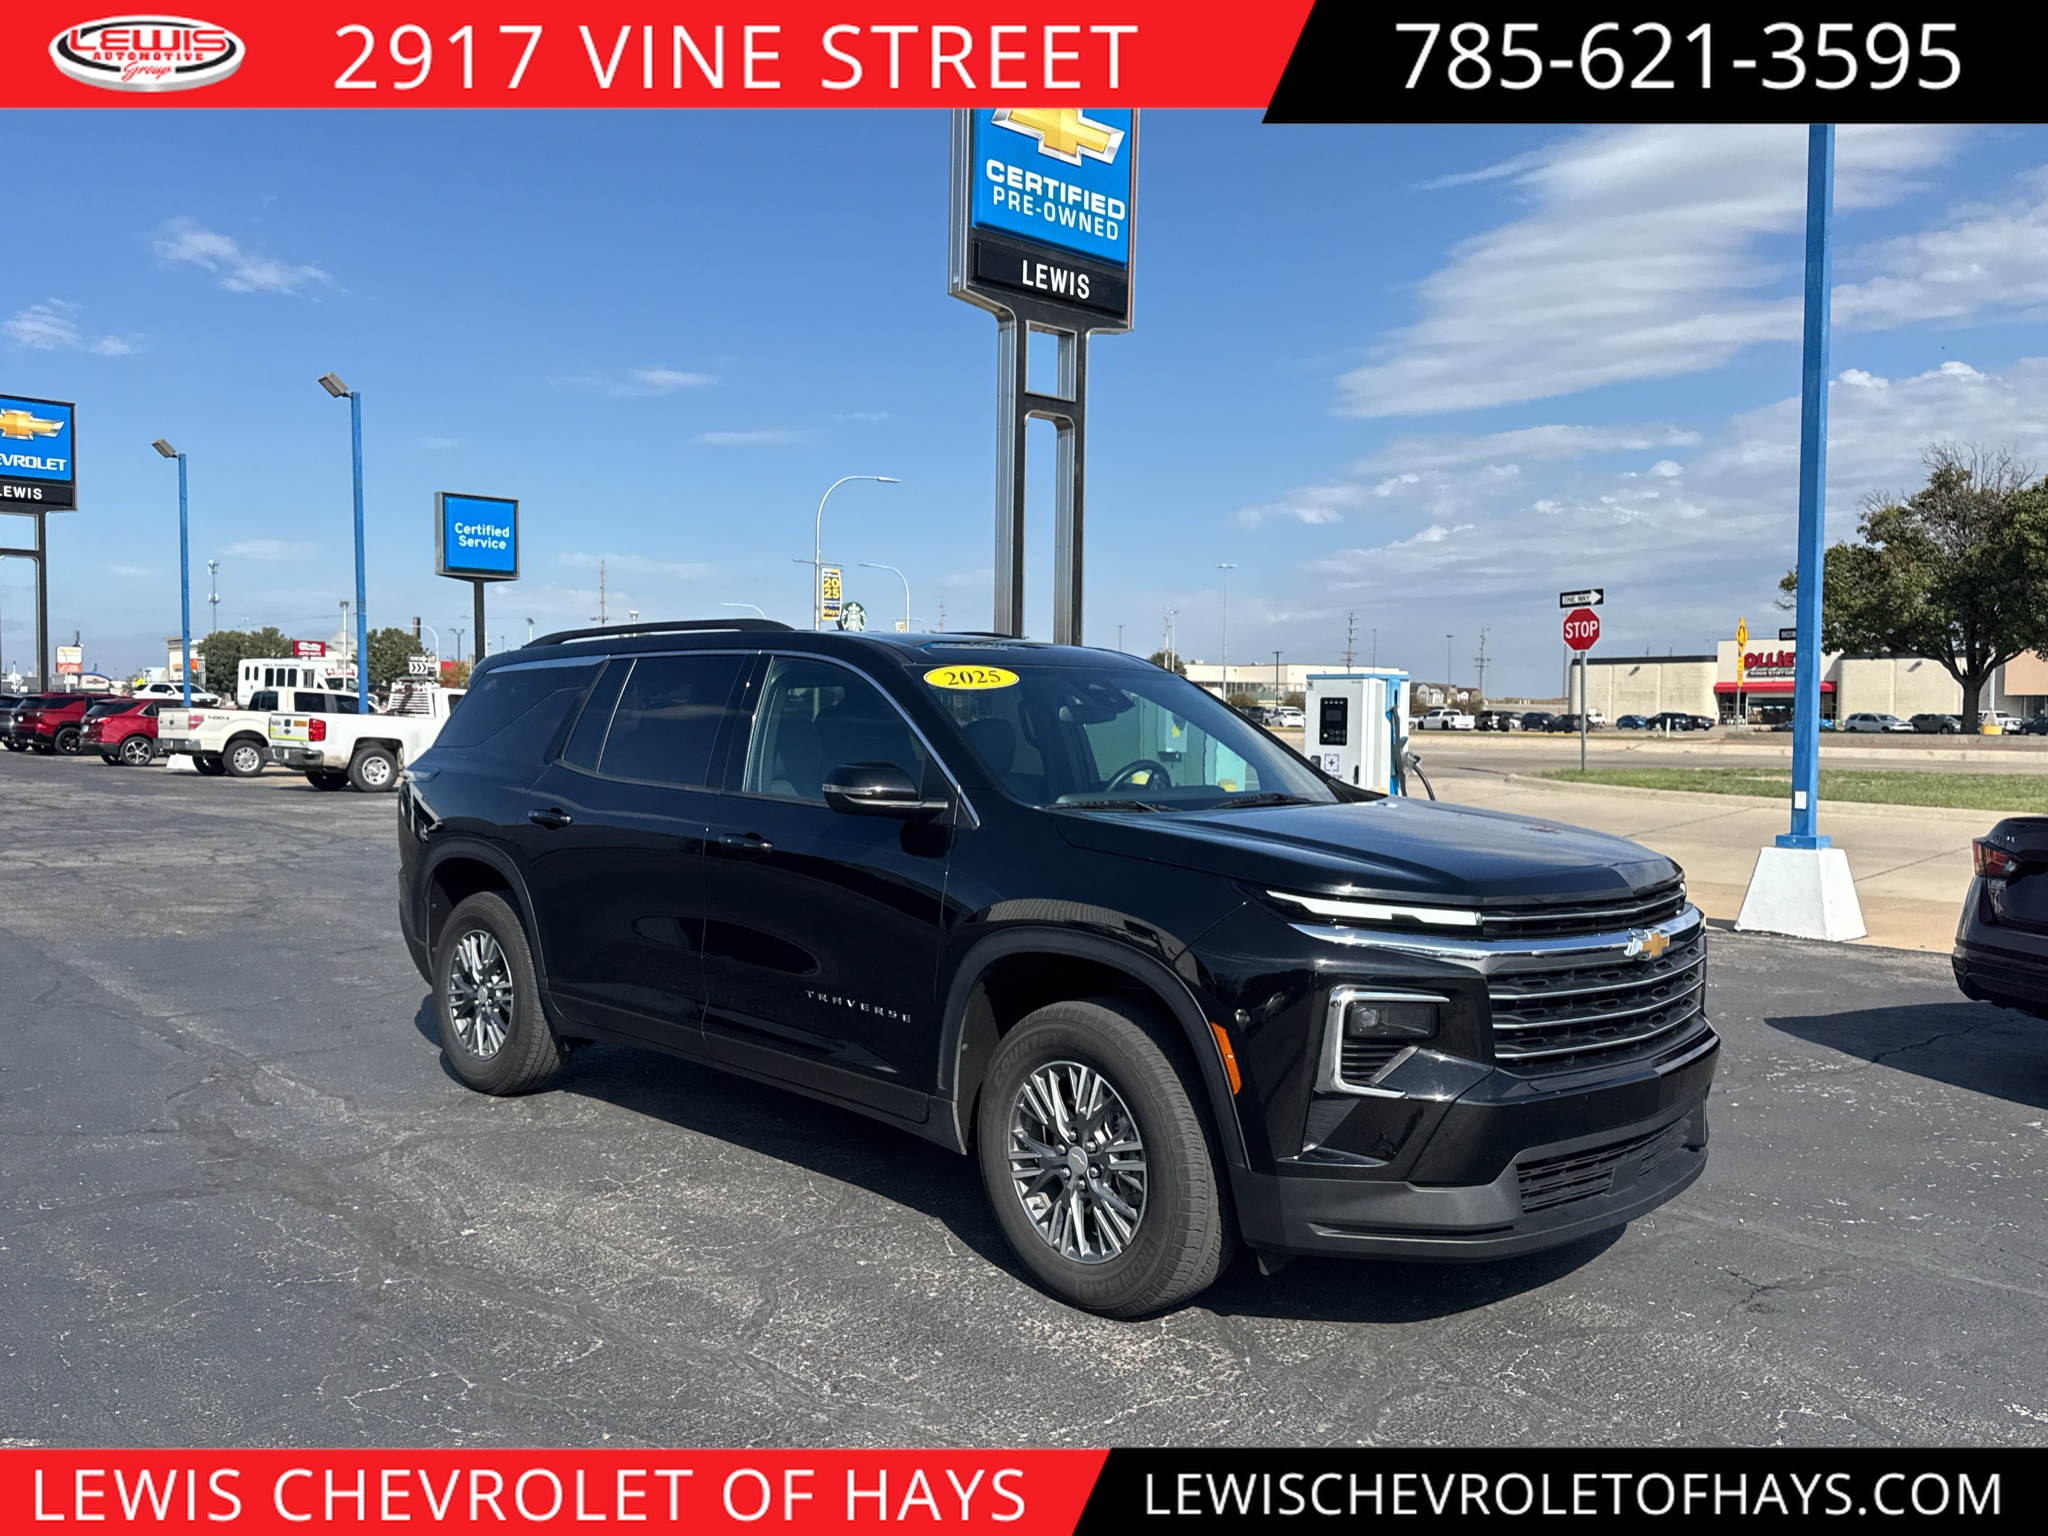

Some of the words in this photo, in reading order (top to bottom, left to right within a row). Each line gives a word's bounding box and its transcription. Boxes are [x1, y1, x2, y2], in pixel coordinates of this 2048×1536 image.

[986, 158, 1126, 221] CERTIFIED
[993, 185, 1119, 241] PRE-OWNED
[1022, 259, 1090, 299] LEWIS
[454, 522, 510, 538] Certified
[458, 535, 507, 550] Service
[1564, 596, 1576, 604] ONE
[1565, 620, 1599, 639] STOP
[943, 670, 1001, 686] 2025
[804, 989, 911, 1023] TRAVERSE
[994, 1032, 1062, 1088] COUNTRY
